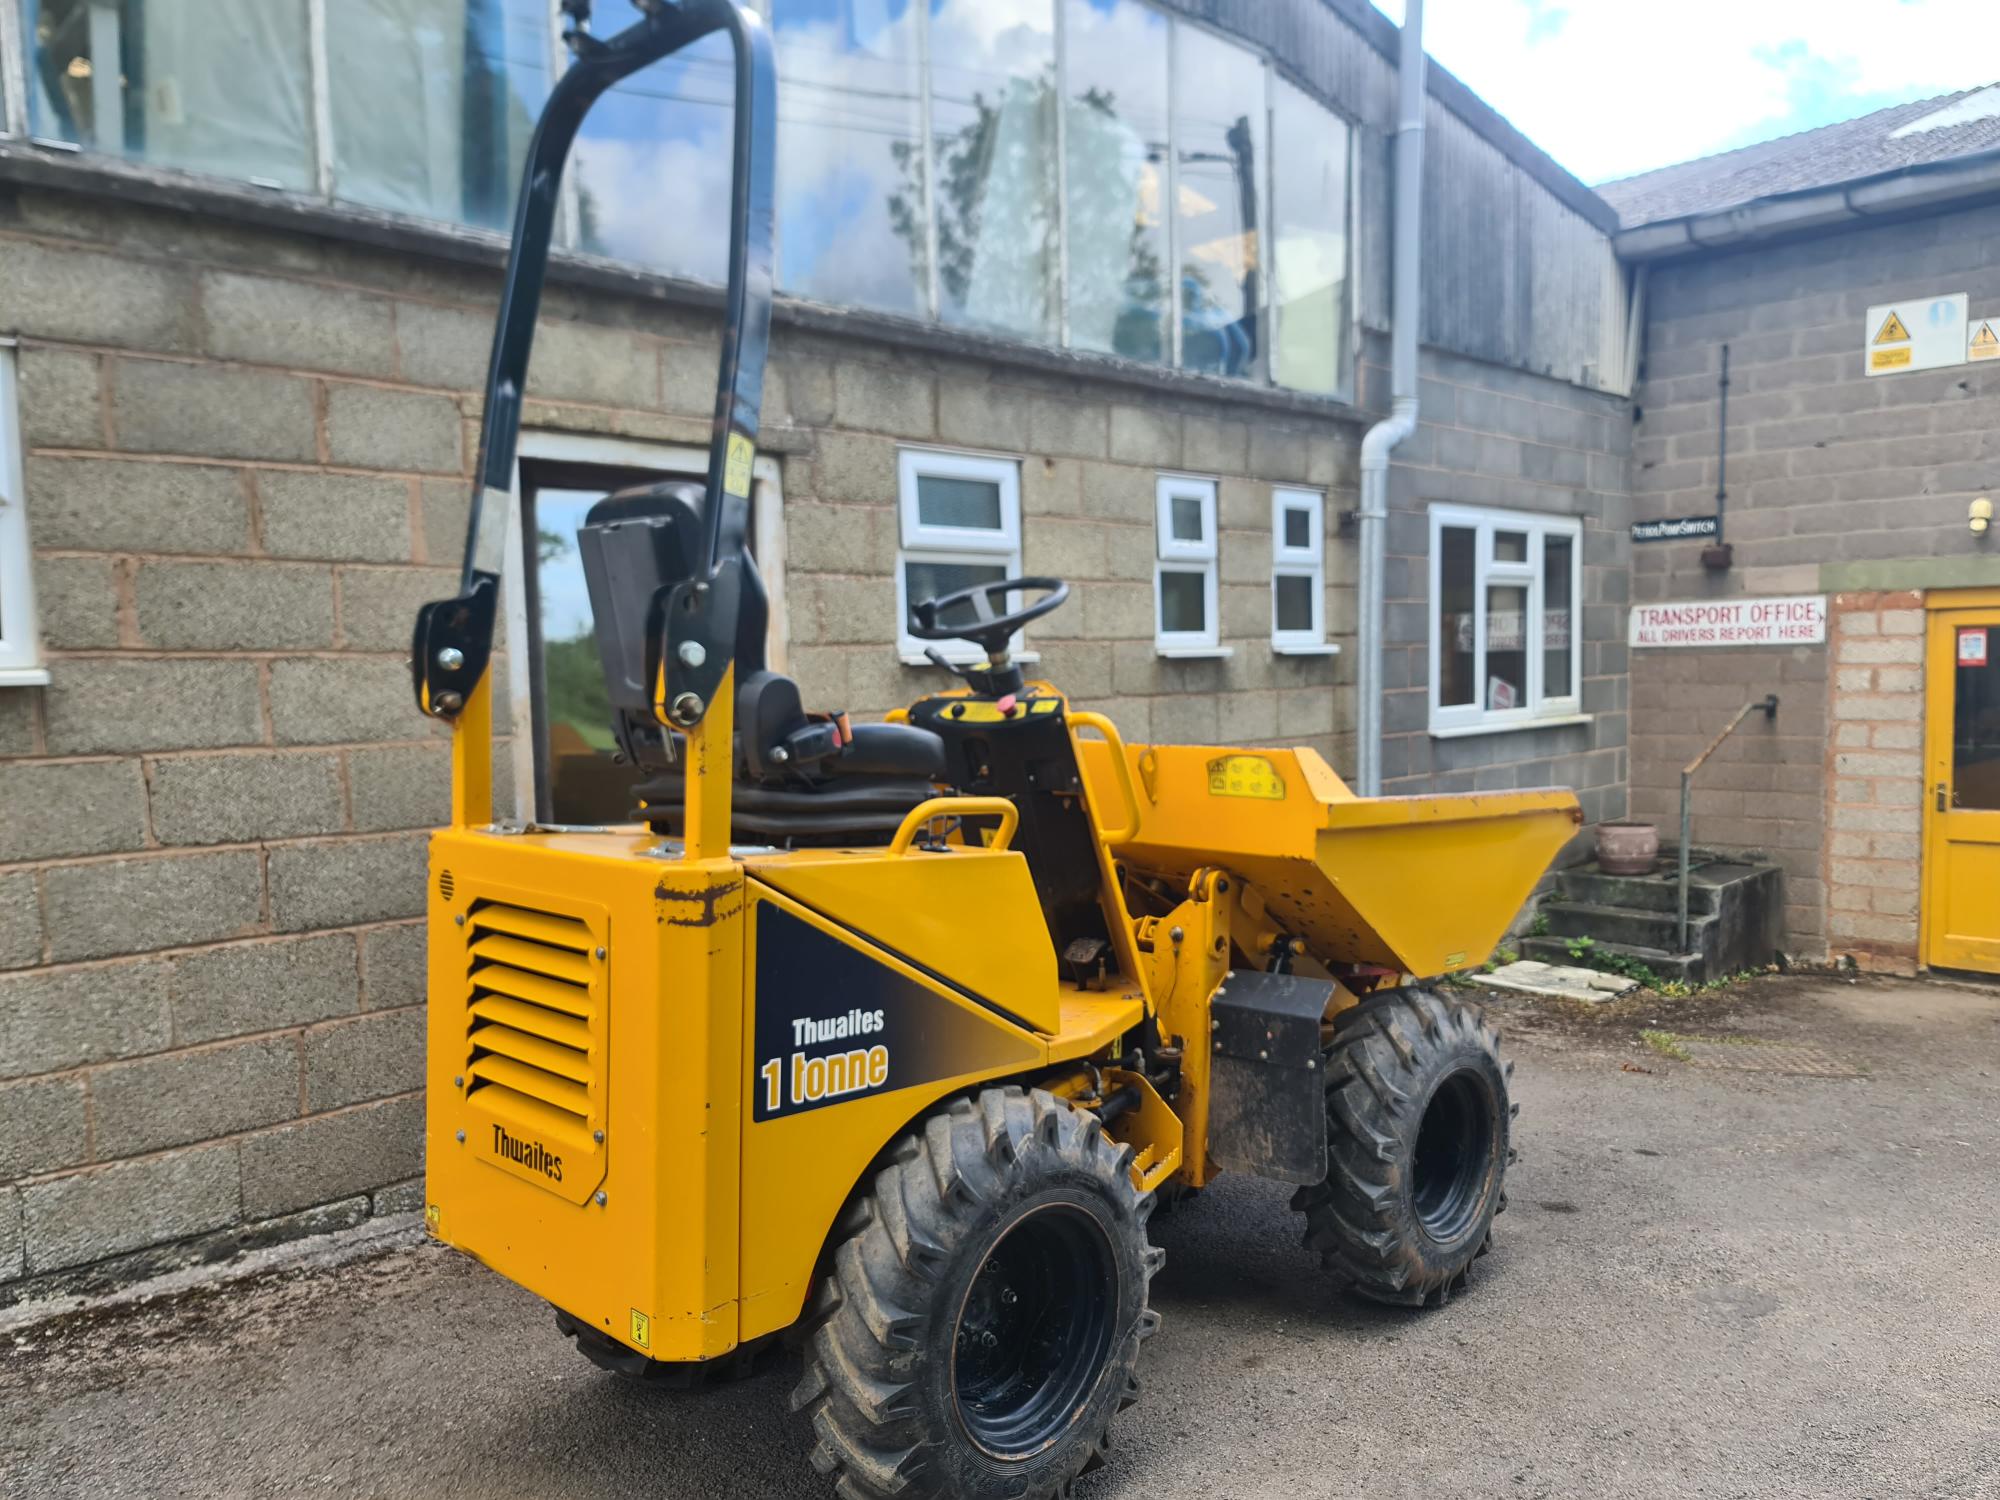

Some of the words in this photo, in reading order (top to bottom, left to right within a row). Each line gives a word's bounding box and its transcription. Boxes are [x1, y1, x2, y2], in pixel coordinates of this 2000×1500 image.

[1637, 628, 1657, 643] ALL
[1662, 627, 1715, 642] DRIVERS
[1719, 626, 1772, 640] REPORT
[1778, 623, 1815, 639] HERE
[1638, 606, 1743, 626] TRANSPORT
[1751, 603, 1816, 623] OFFICE
[792, 1008, 884, 1047] Thwaites
[762, 1057, 782, 1111] 1
[791, 1045, 889, 1105] tonne
[492, 1123, 563, 1183] Thwaites
